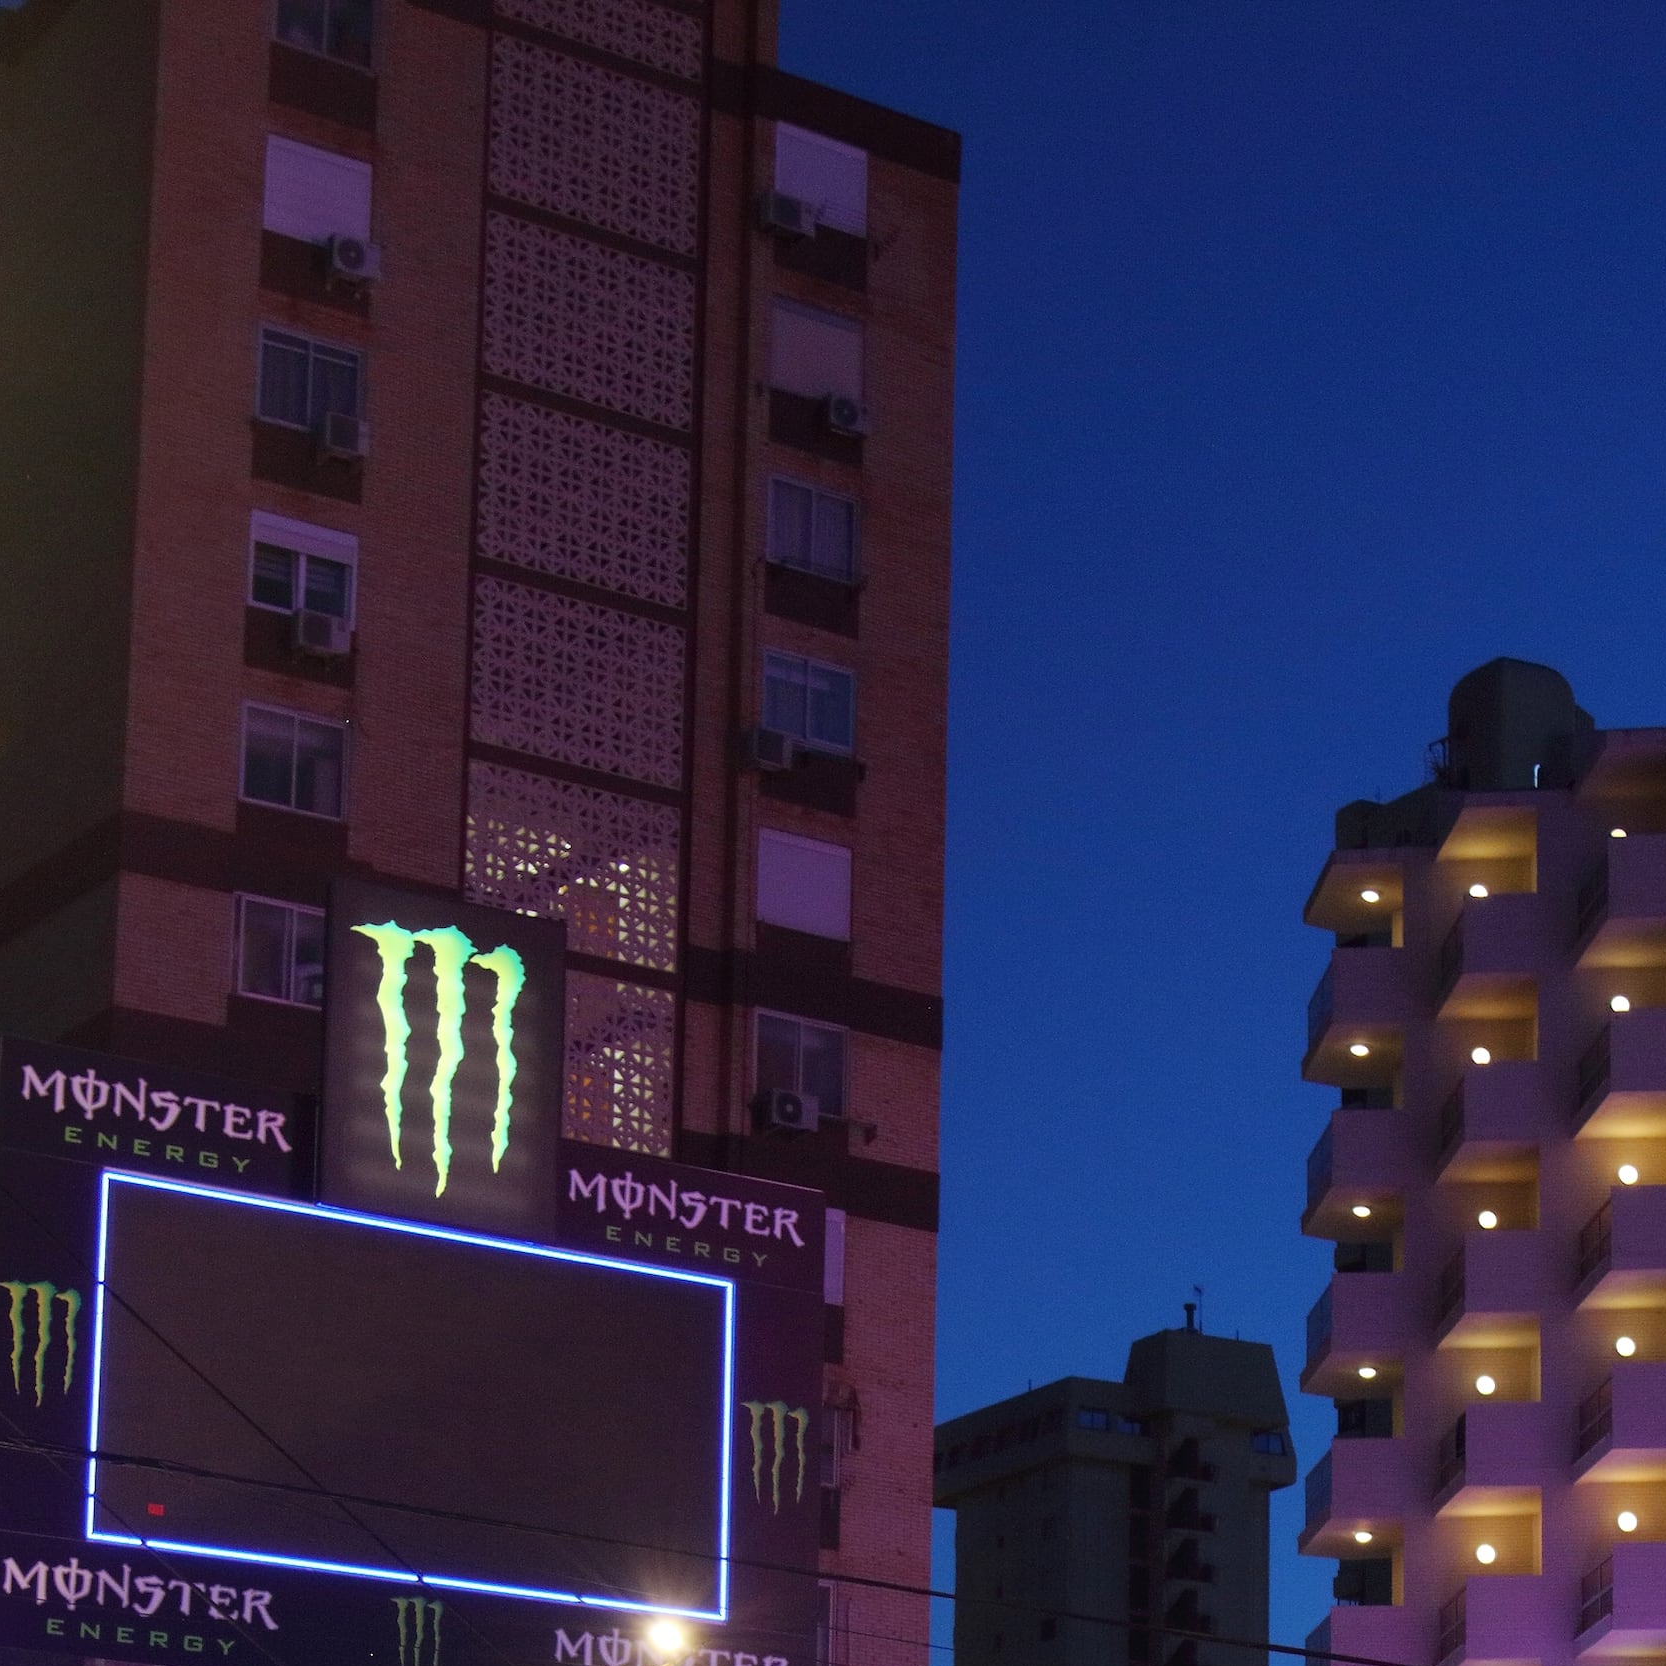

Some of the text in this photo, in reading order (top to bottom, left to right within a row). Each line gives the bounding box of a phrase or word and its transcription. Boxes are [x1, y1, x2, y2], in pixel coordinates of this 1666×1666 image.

[20, 1063, 293, 1154] MONSTER
[62, 1125, 252, 1175] ENERGY
[567, 1167, 805, 1249] MONSTER
[604, 1225, 770, 1269] ENERGY
[1, 1556, 279, 1632] MONSTER
[45, 1617, 236, 1657] ENERGY
